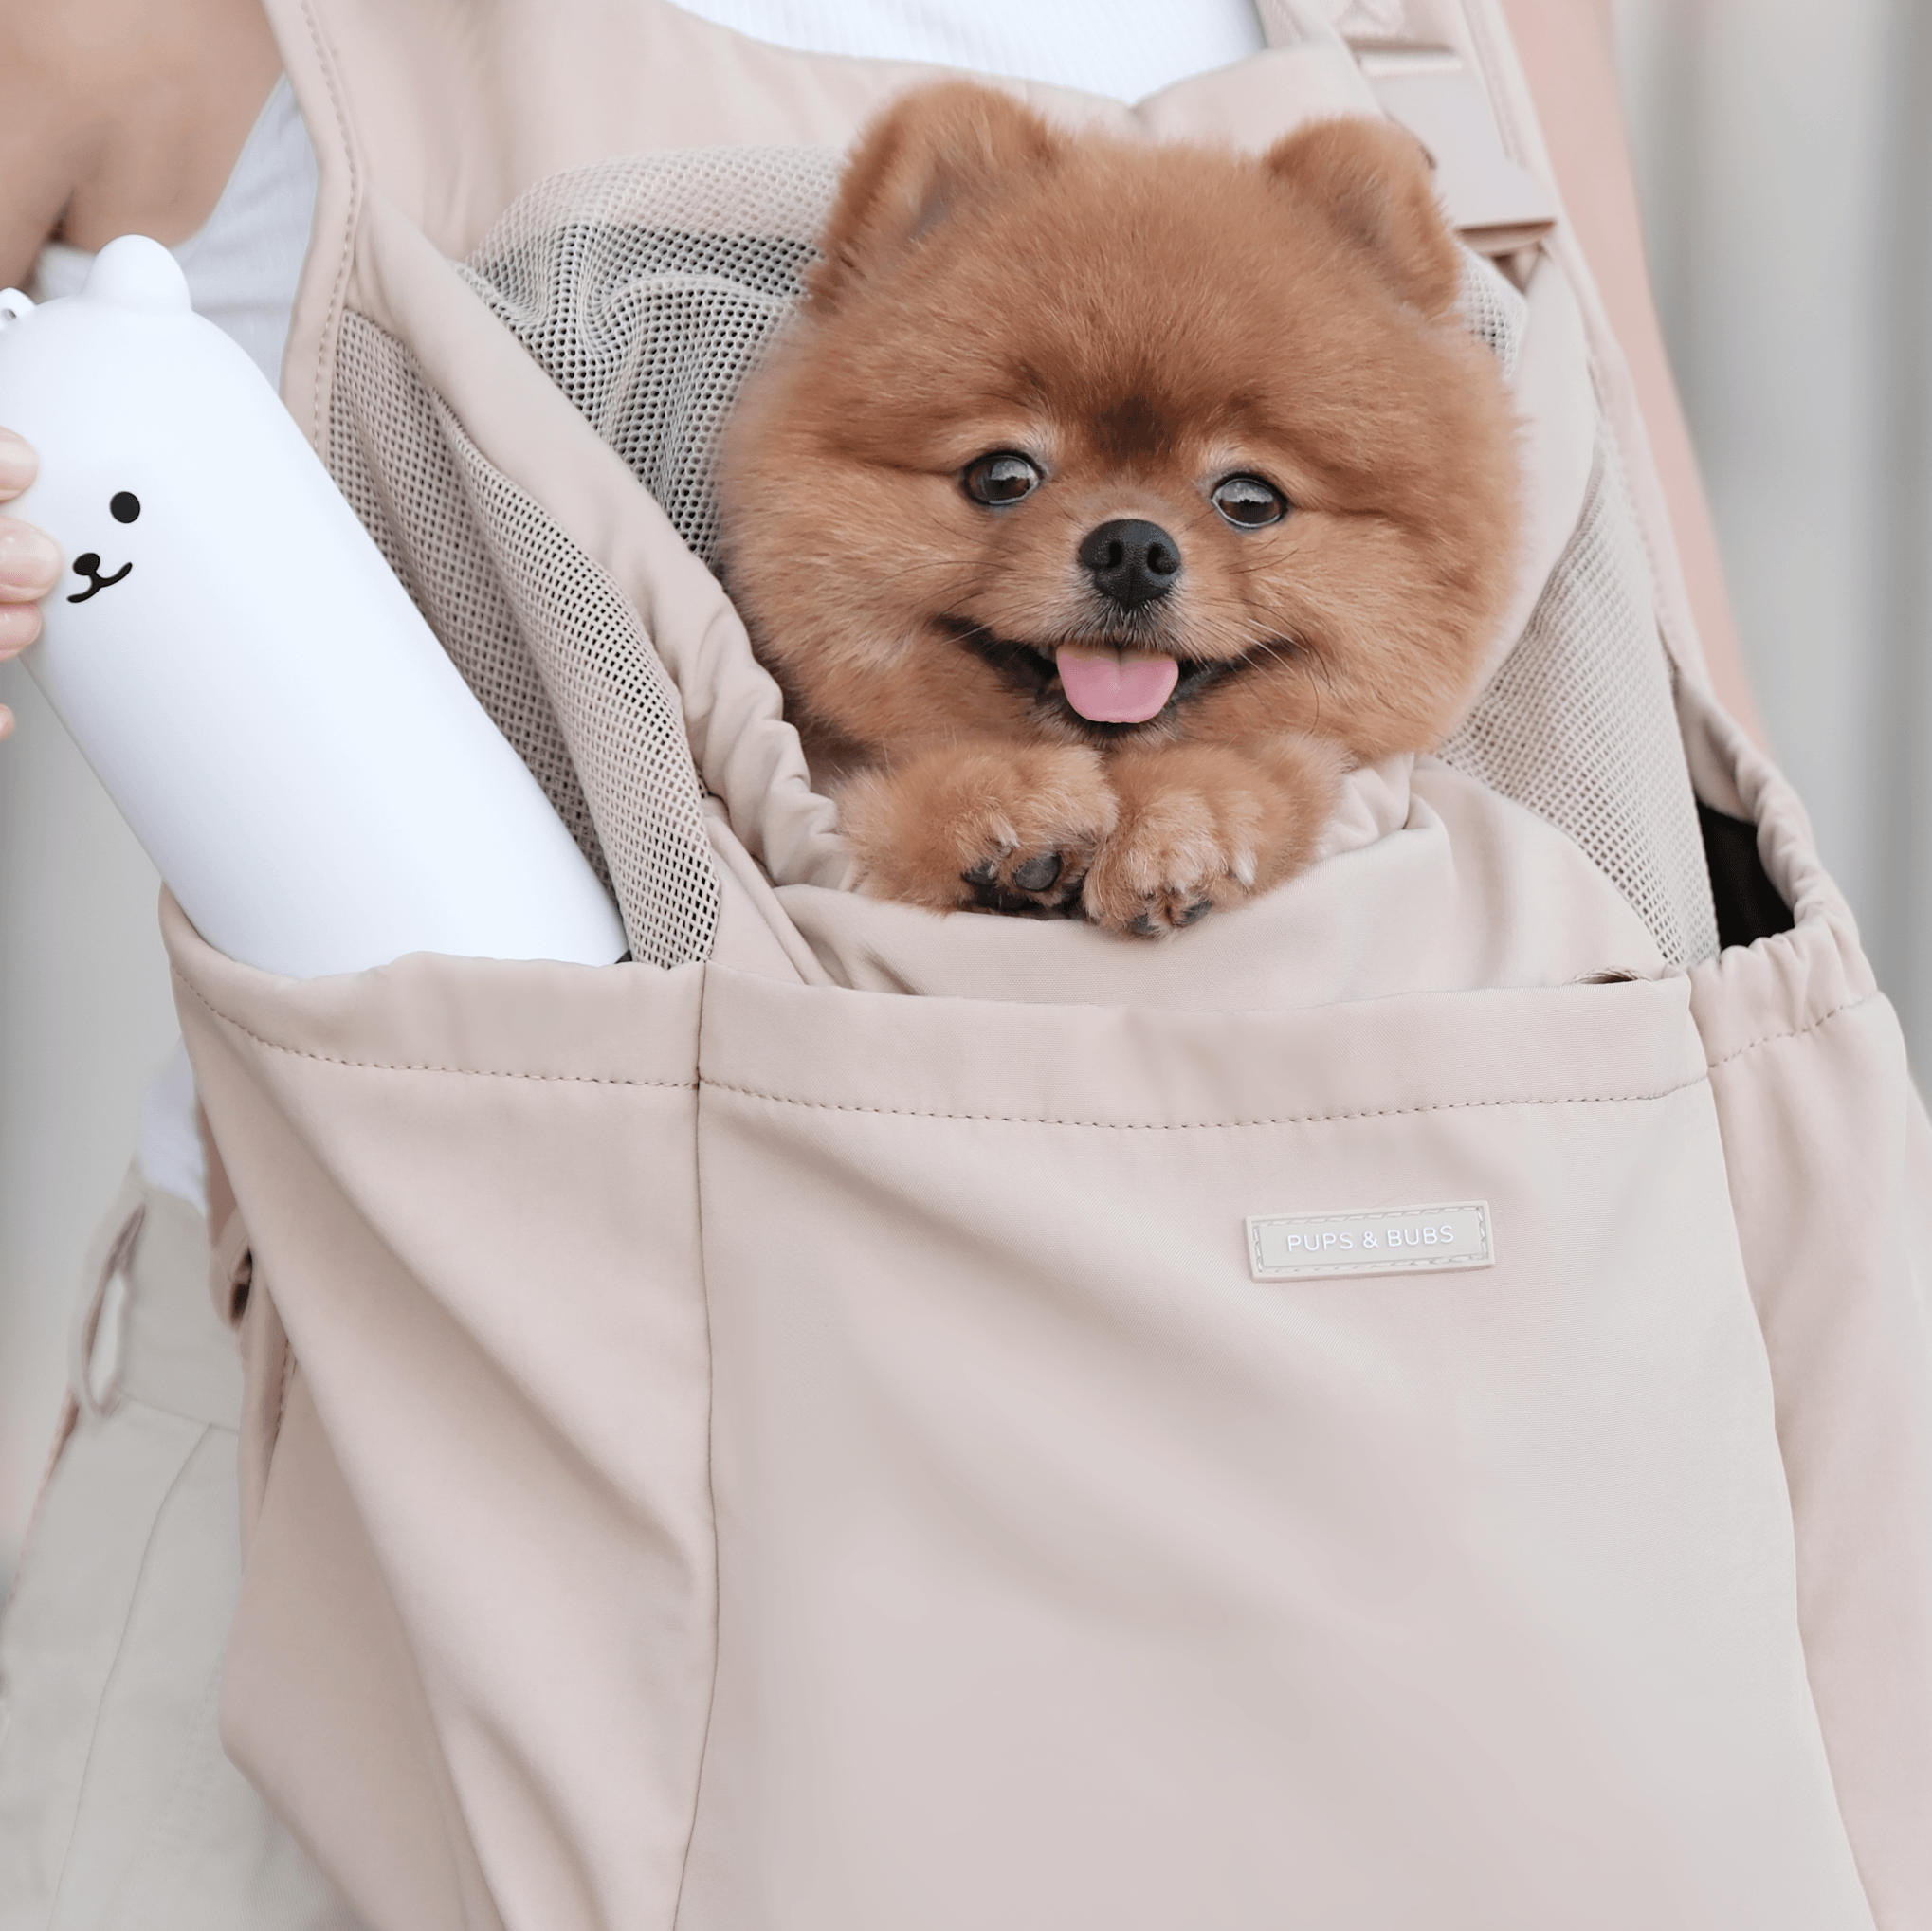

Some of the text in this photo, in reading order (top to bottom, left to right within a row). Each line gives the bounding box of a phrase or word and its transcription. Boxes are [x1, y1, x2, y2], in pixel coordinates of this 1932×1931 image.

[1286, 1225, 1454, 1252] PUPS & BUBS
